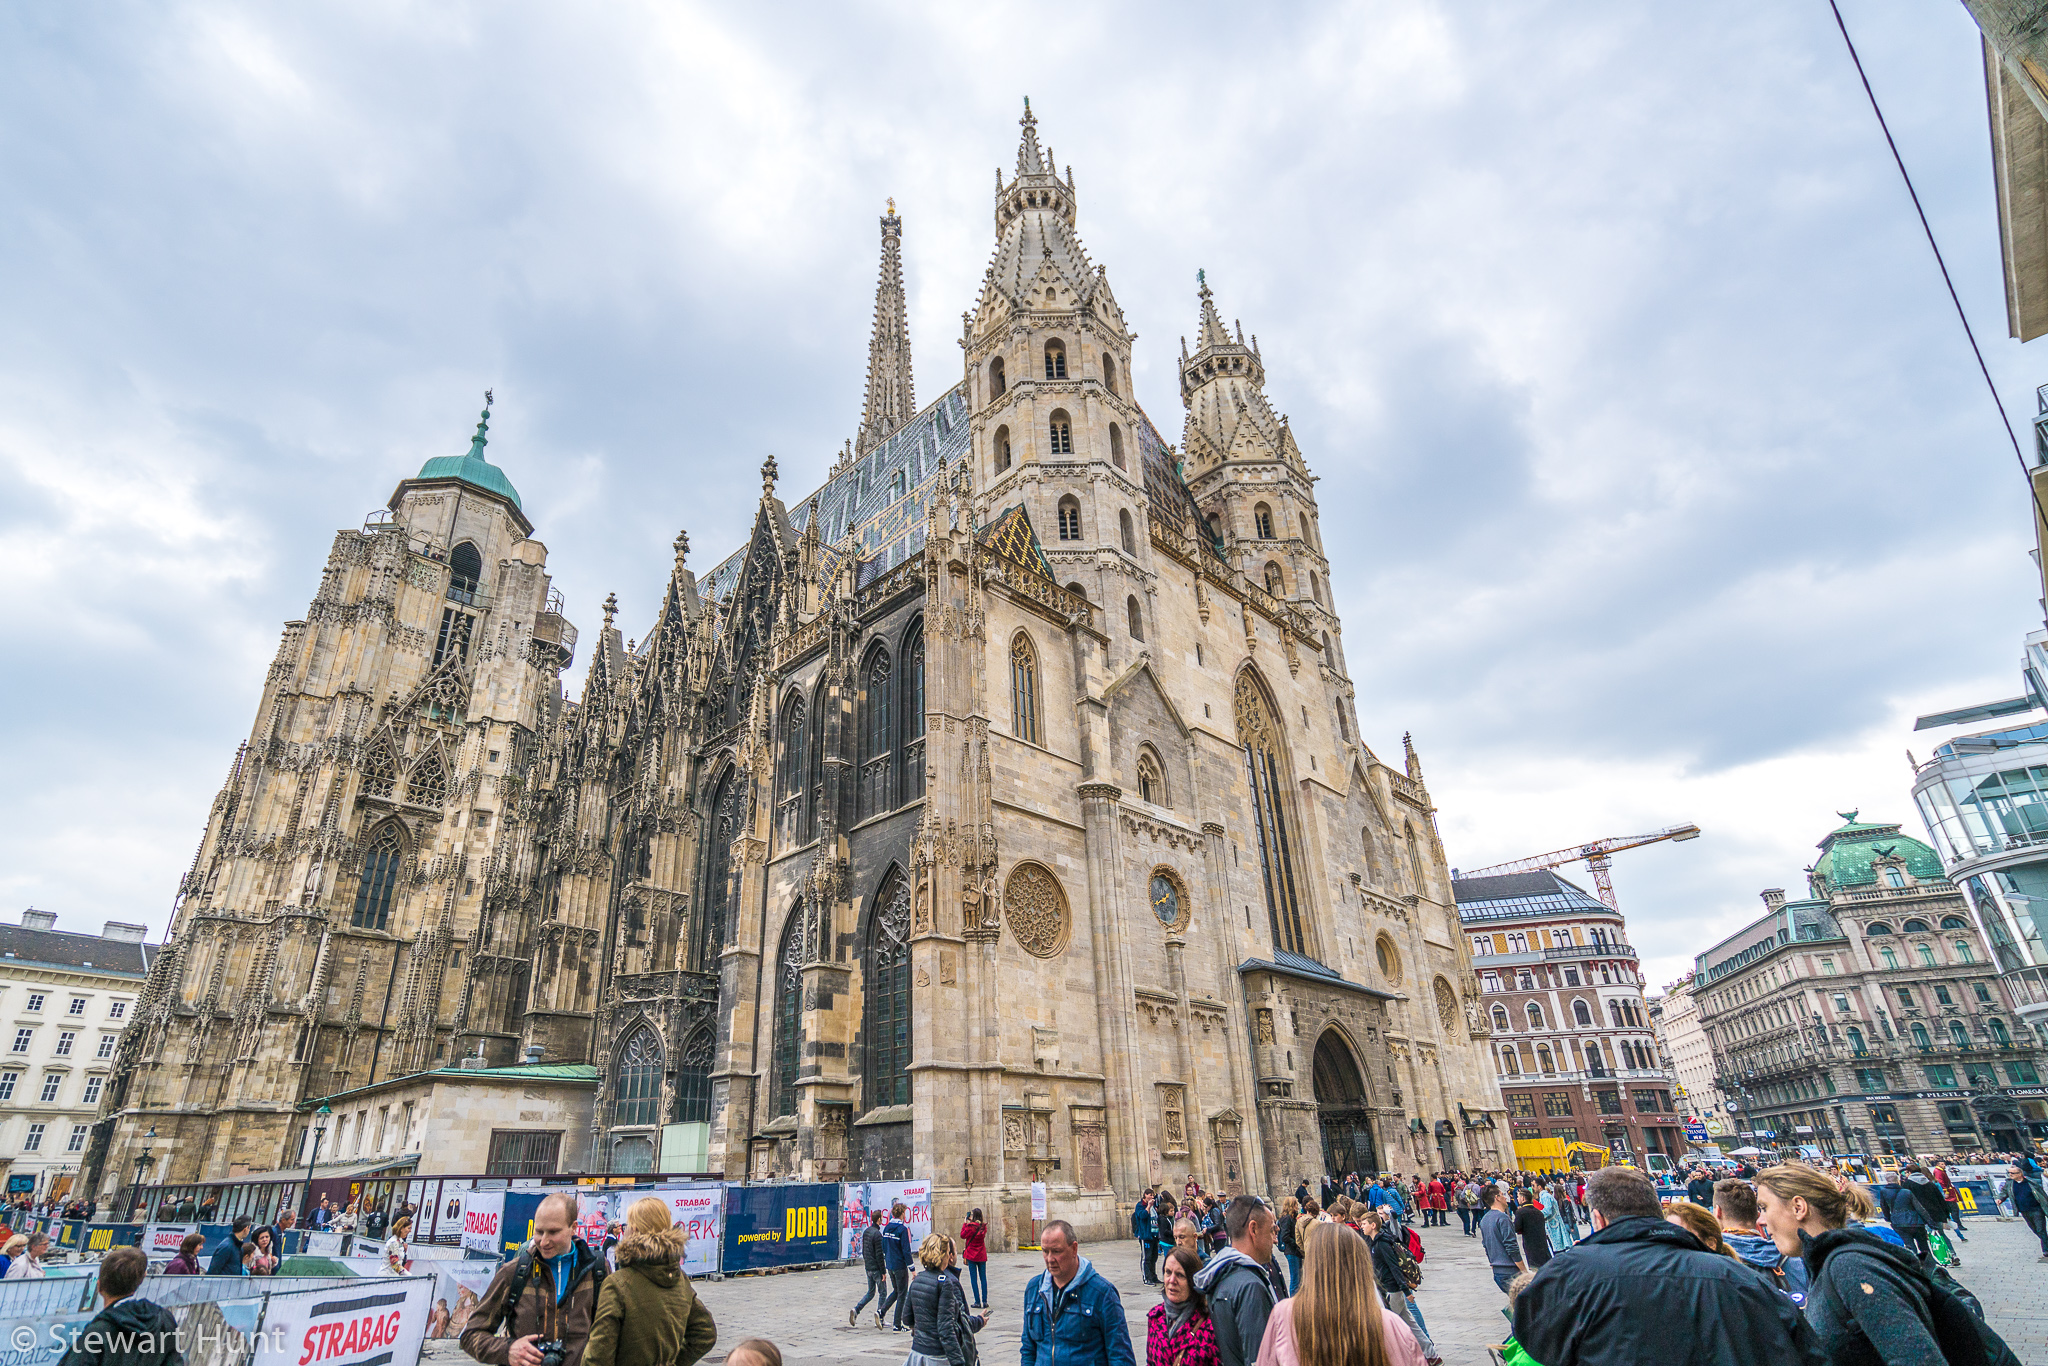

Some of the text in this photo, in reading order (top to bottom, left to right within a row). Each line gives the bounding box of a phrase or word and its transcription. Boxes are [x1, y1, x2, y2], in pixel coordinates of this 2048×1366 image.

[675, 1198, 711, 1208] STRABAG
[904, 1187, 925, 1196] STRABAG
[464, 1211, 498, 1236] STRABAG
[738, 1206, 828, 1245] powered by PORR
[299, 1310, 401, 1366] STRABAG
